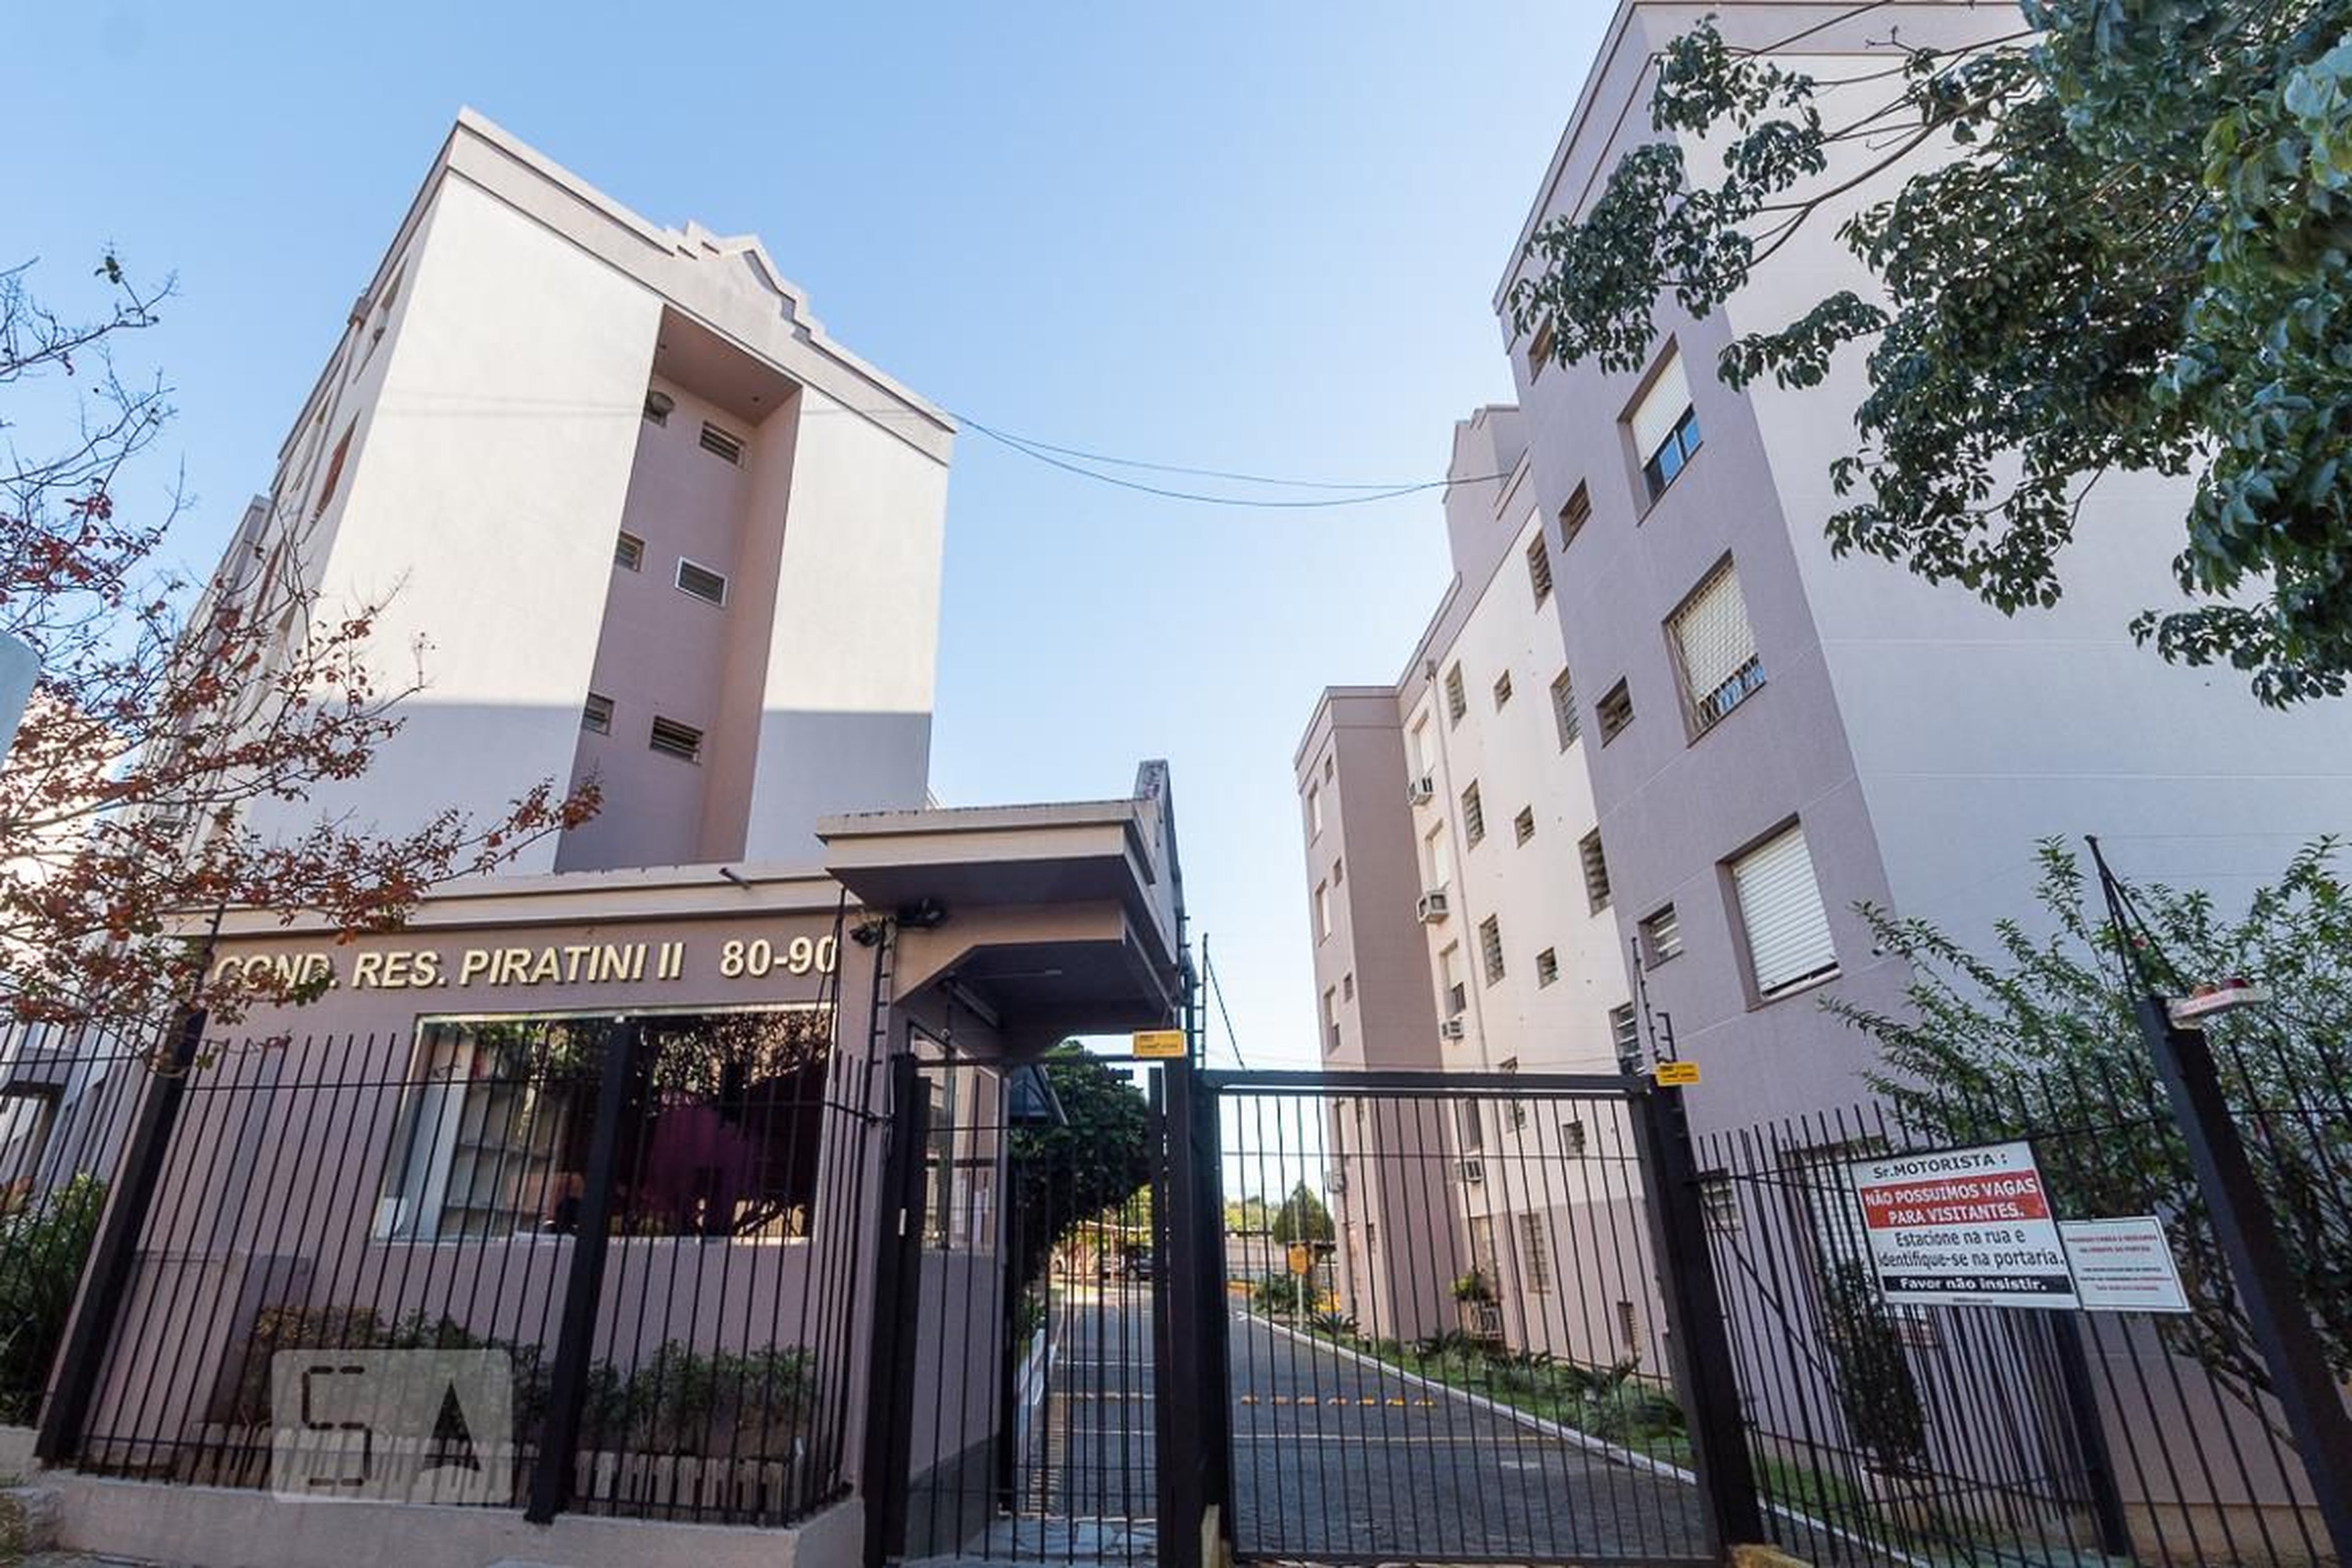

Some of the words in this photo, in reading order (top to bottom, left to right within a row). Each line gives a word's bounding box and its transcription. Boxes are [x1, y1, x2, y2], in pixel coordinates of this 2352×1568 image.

[352, 951, 446, 988] RES.
[459, 944, 646, 986] PIRATINI
[658, 942, 684, 979] II
[720, 935, 838, 977] 80-90
[1866, 1188, 1893, 1207] NÃO
[1980, 1177, 2038, 1197] VAGAS
[1888, 1208, 1926, 1226] PARA
[1927, 1201, 2025, 1224] VISITANTES.
[1894, 1229, 1959, 1247] Estacione
[1963, 1231, 1983, 1244] na
[1986, 1229, 2011, 1244] rua
[2015, 1229, 2026, 1243] e
[1972, 1252, 1991, 1267] na
[1994, 1247, 2065, 1268] portaria.
[1899, 1276, 1942, 1290] Favor
[1946, 1276, 1977, 1290] não
[1980, 1276, 2048, 1291] insistir.
